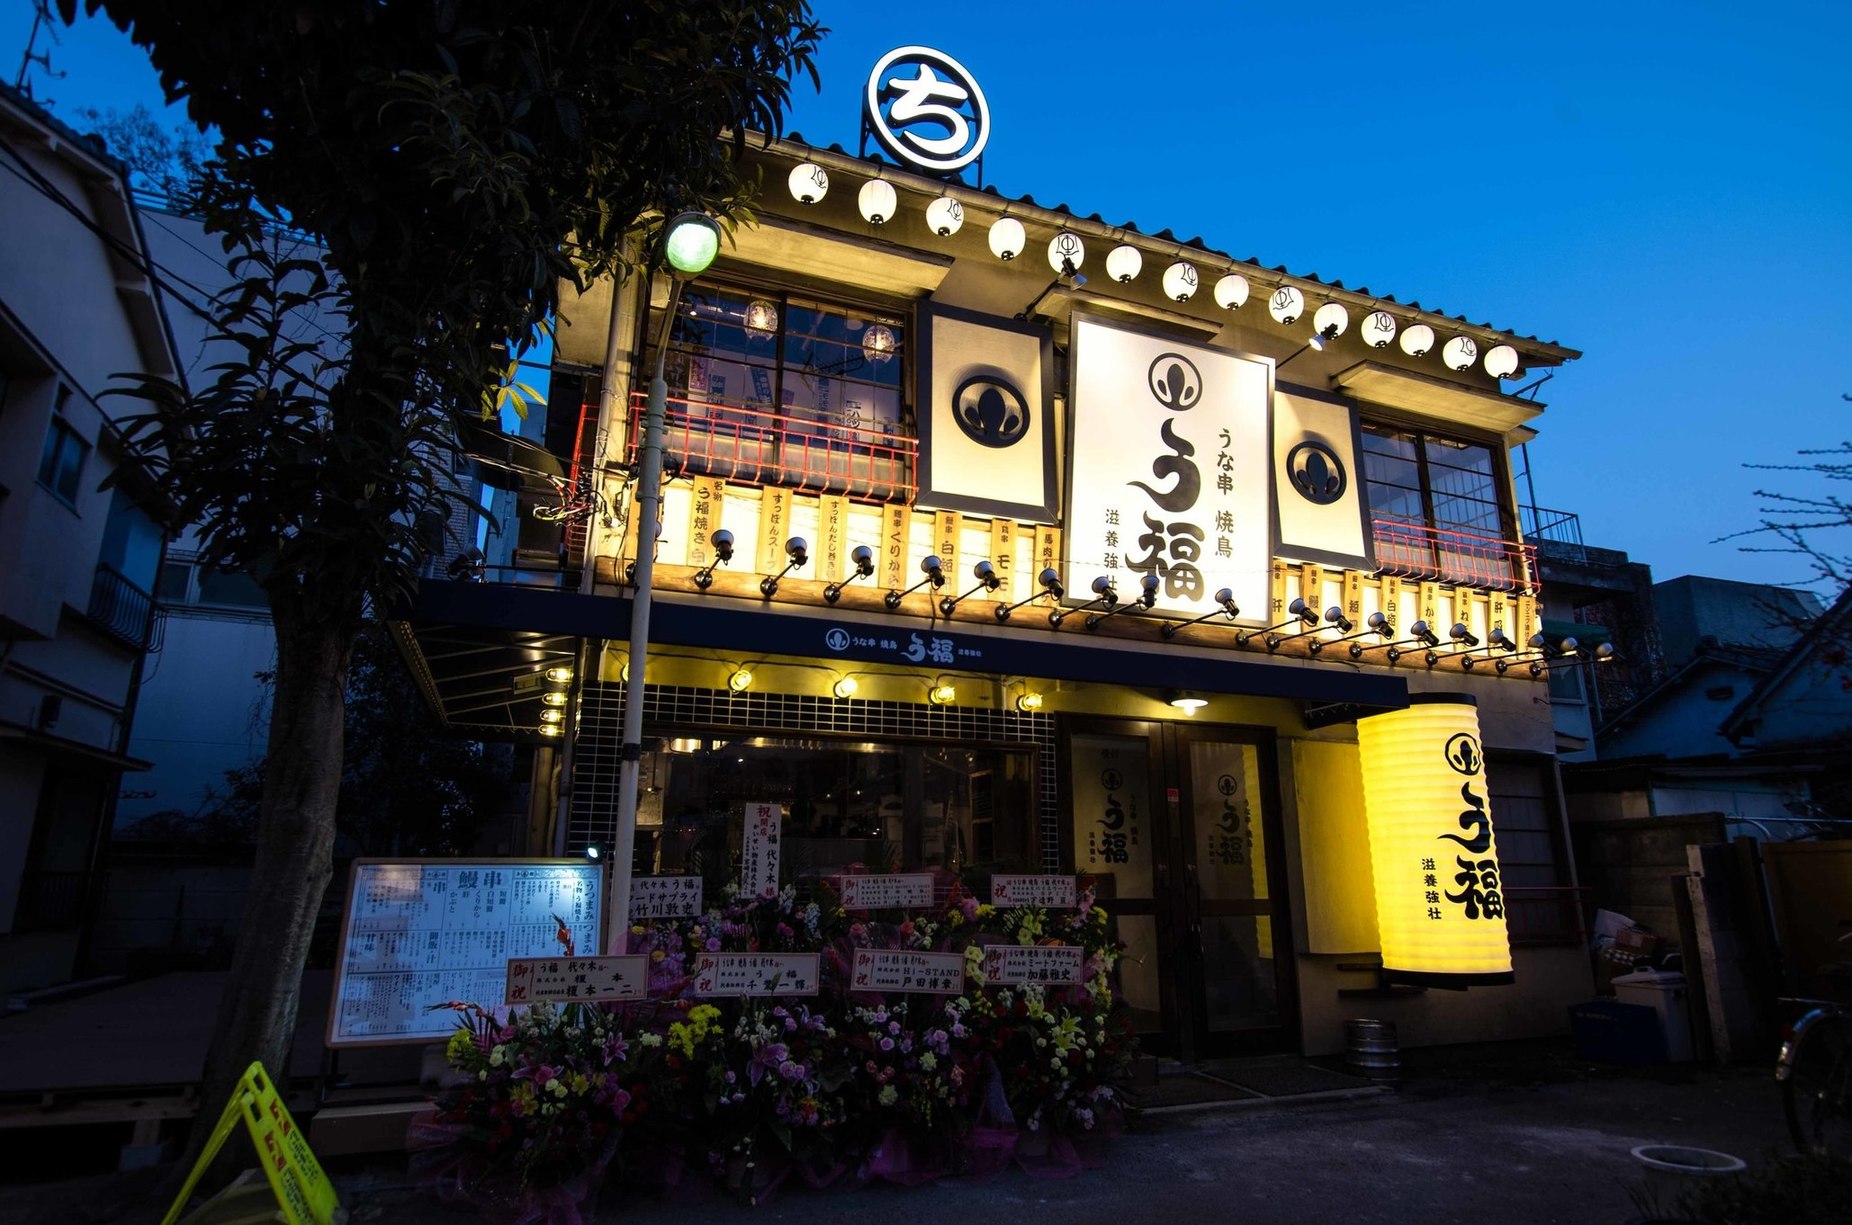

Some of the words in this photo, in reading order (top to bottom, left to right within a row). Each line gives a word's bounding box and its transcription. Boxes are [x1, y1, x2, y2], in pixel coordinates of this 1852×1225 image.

[1216, 428, 1234, 495] うな串
[1125, 417, 1205, 602] う福
[1215, 509, 1234, 558] 焼鳥
[900, 632, 954, 664] う福
[1097, 793, 1129, 864] う福
[1437, 781, 1503, 920] う福
[584, 881, 596, 920] うつまみ
[1422, 858, 1442, 920] 滋養強壮
[582, 924, 594, 954] つまみ
[540, 962, 558, 974] う福
